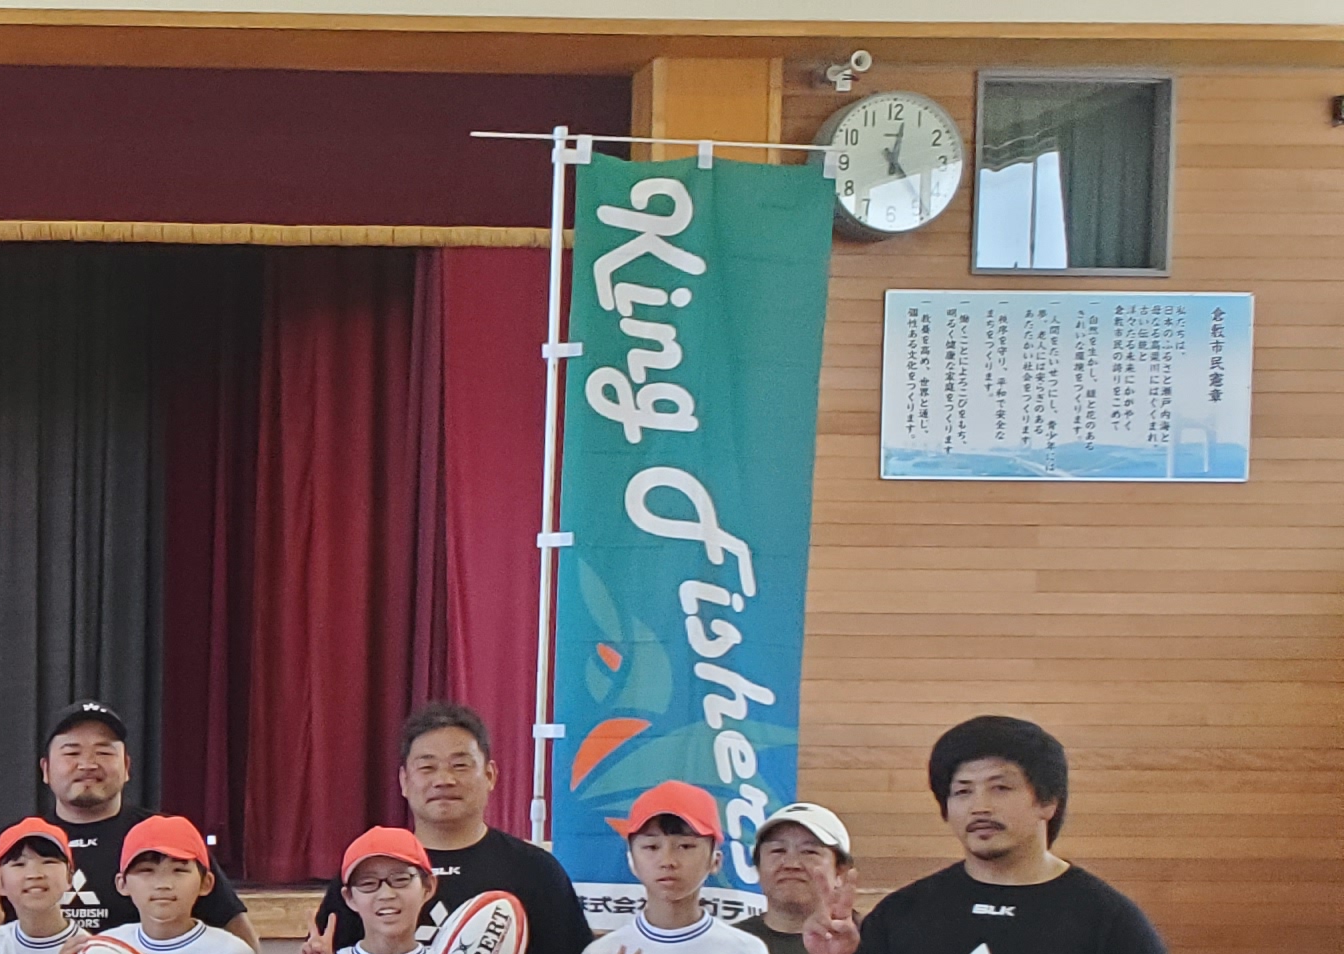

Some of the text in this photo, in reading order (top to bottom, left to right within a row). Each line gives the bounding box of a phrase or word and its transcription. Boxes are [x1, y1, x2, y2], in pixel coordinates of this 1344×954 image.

[864, 110, 876, 127] 11
[888, 103, 904, 120] 12
[918, 111, 921, 127] 1
[845, 129, 858, 145] 10
[932, 129, 942, 146] 2
[839, 154, 849, 170] 9
[938, 155, 947, 171] 3
[844, 180, 854, 196] 8
[862, 199, 870, 215] 7
[886, 206, 896, 222] 6
[585, 177, 706, 444] King
[1207, 307, 1226, 403] 倉敷市民憲章
[972, 903, 1016, 917] BLK
